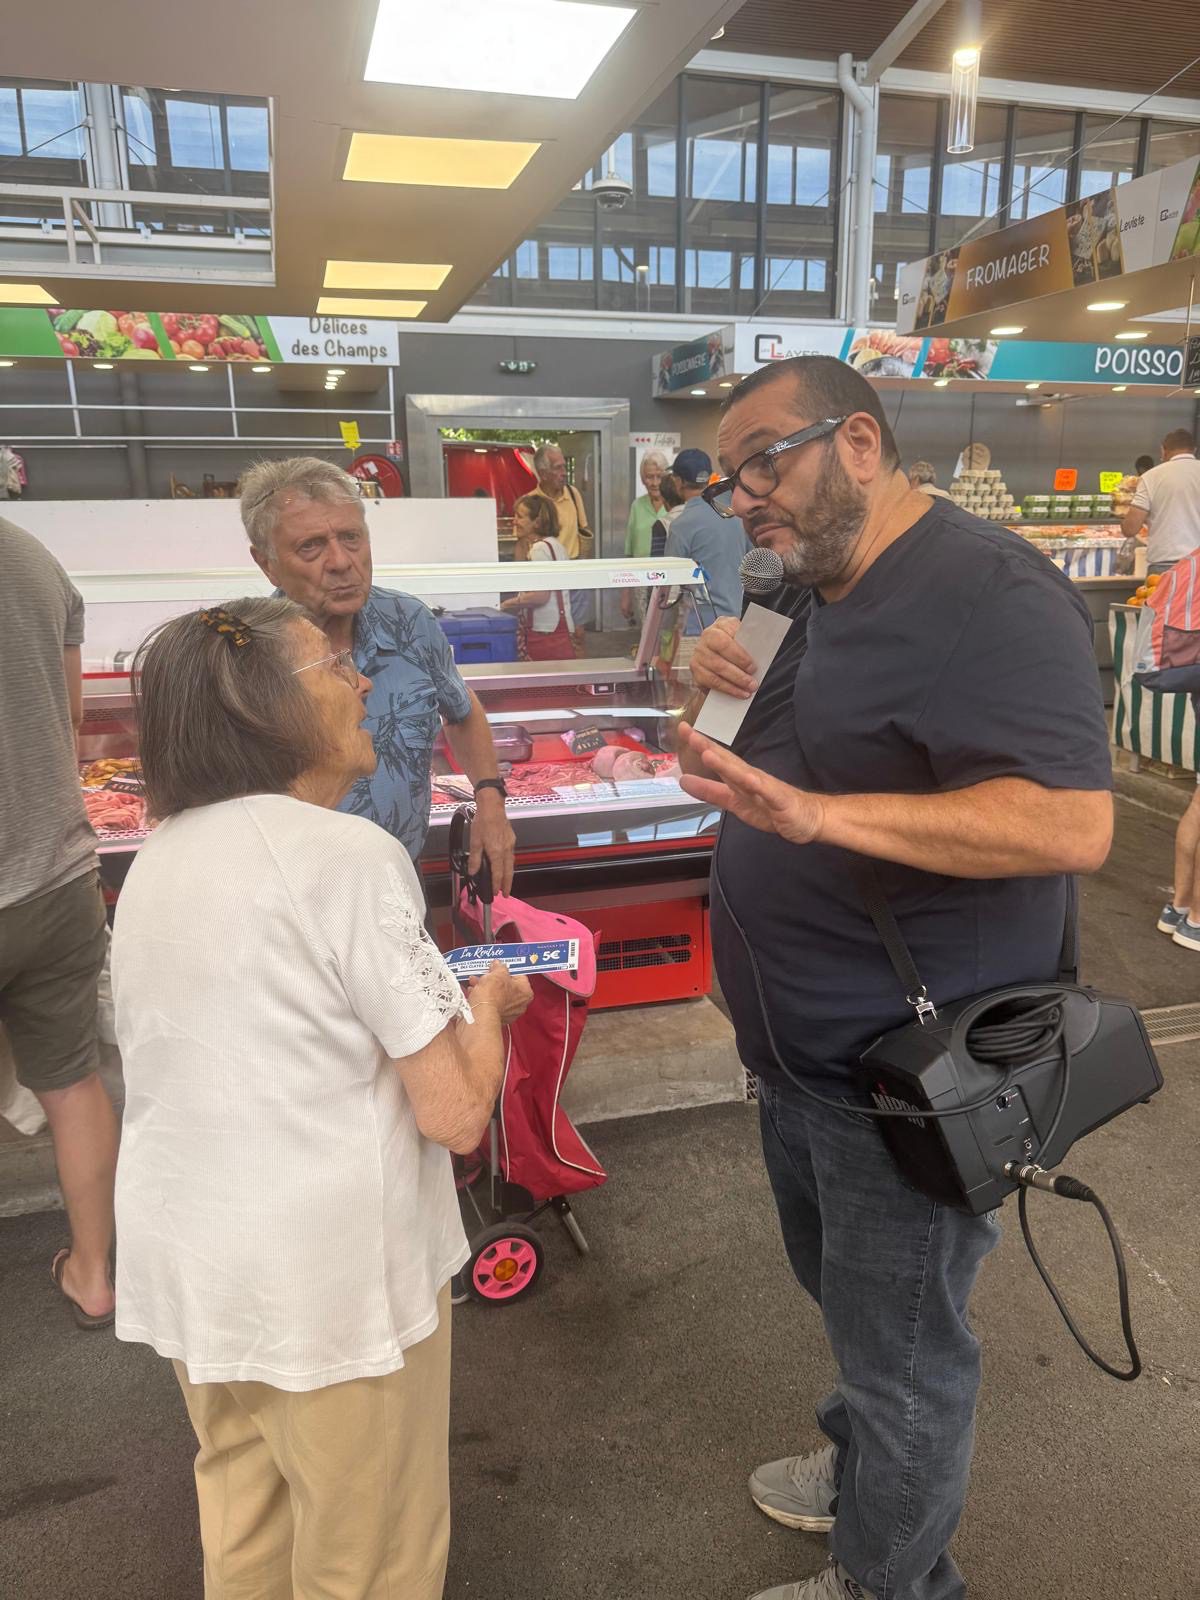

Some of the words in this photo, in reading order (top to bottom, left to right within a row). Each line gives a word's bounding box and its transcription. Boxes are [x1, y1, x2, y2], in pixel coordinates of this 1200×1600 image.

[965, 244, 1050, 291] FROMAGER
[309, 316, 368, 335] Délices
[291, 339, 320, 356] des
[324, 339, 388, 363] Champs
[1095, 346, 1184, 377] POISSO
[542, 949, 561, 962] 5€
